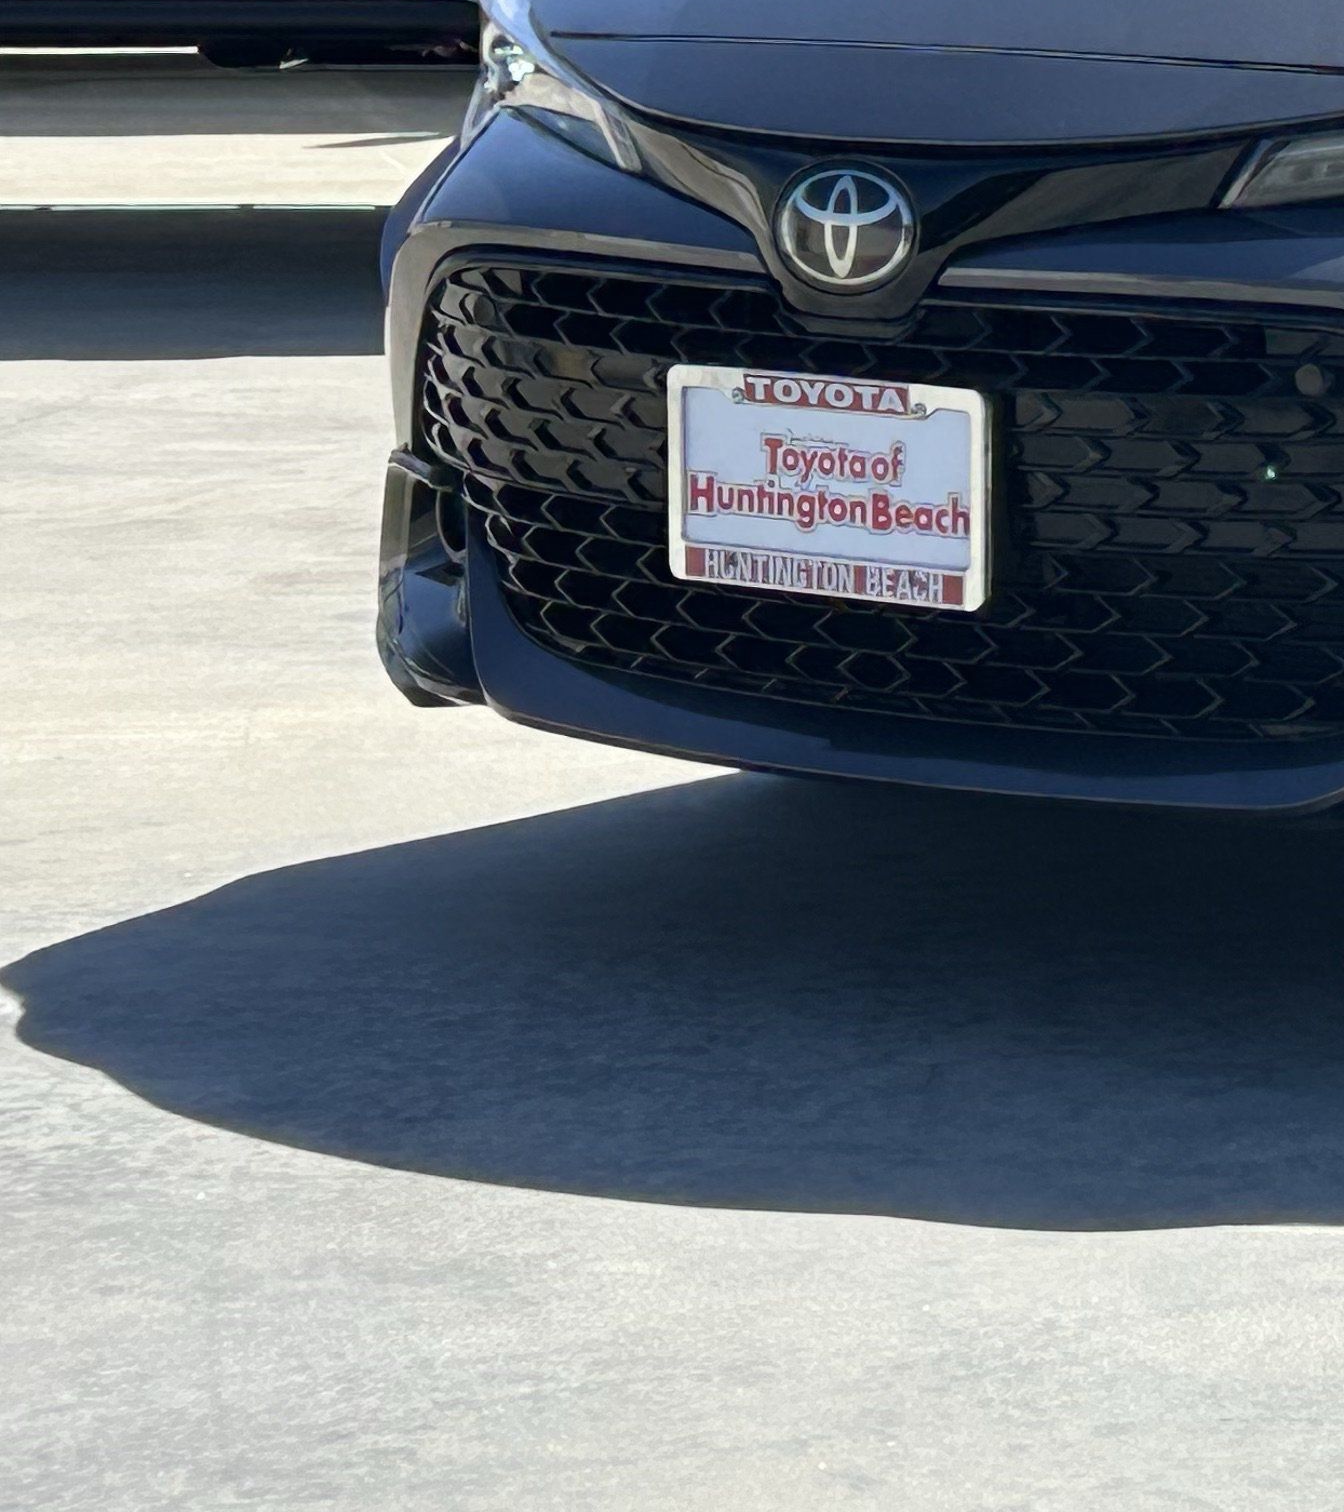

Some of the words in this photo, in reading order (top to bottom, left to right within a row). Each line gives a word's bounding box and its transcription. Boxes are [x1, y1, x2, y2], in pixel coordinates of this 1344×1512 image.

[747, 378, 905, 413] TOYOTA
[764, 437, 868, 484] Toyota
[870, 442, 904, 483] of
[690, 474, 868, 529] Huntington
[872, 492, 970, 536] Beach
[704, 548, 854, 594] HUNTINGTON
[864, 564, 944, 604] BEACH
